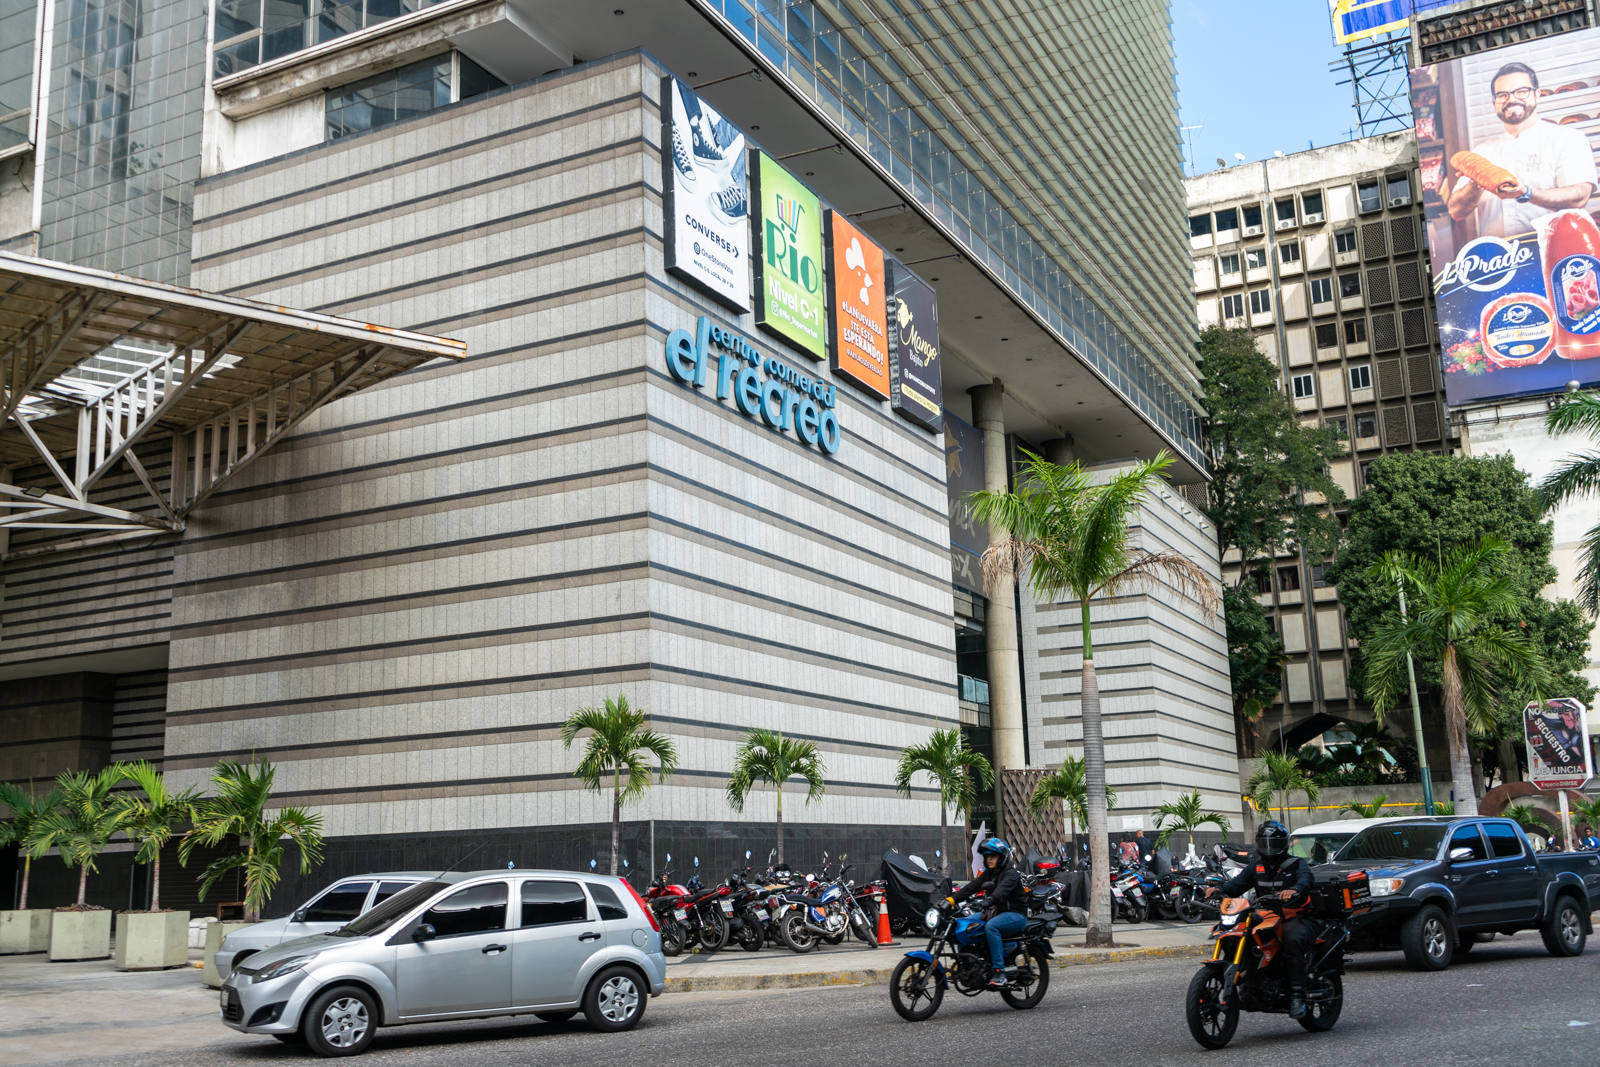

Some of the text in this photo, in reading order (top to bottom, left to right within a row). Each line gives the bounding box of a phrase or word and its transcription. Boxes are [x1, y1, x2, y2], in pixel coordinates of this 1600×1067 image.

[685, 214, 731, 253] CONVERSE
[768, 275, 818, 326] Nivel C-1
[709, 323, 837, 409] centro comercial
[843, 327, 883, 366] ESPERANDO!
[900, 325, 937, 367] Mango
[666, 315, 841, 454] el recreo
[1528, 708, 1541, 716] NO
[1530, 736, 1543, 746] 171
[1534, 717, 1570, 763] SECUESTRO
[1535, 766, 1583, 775] DENUNCIA
